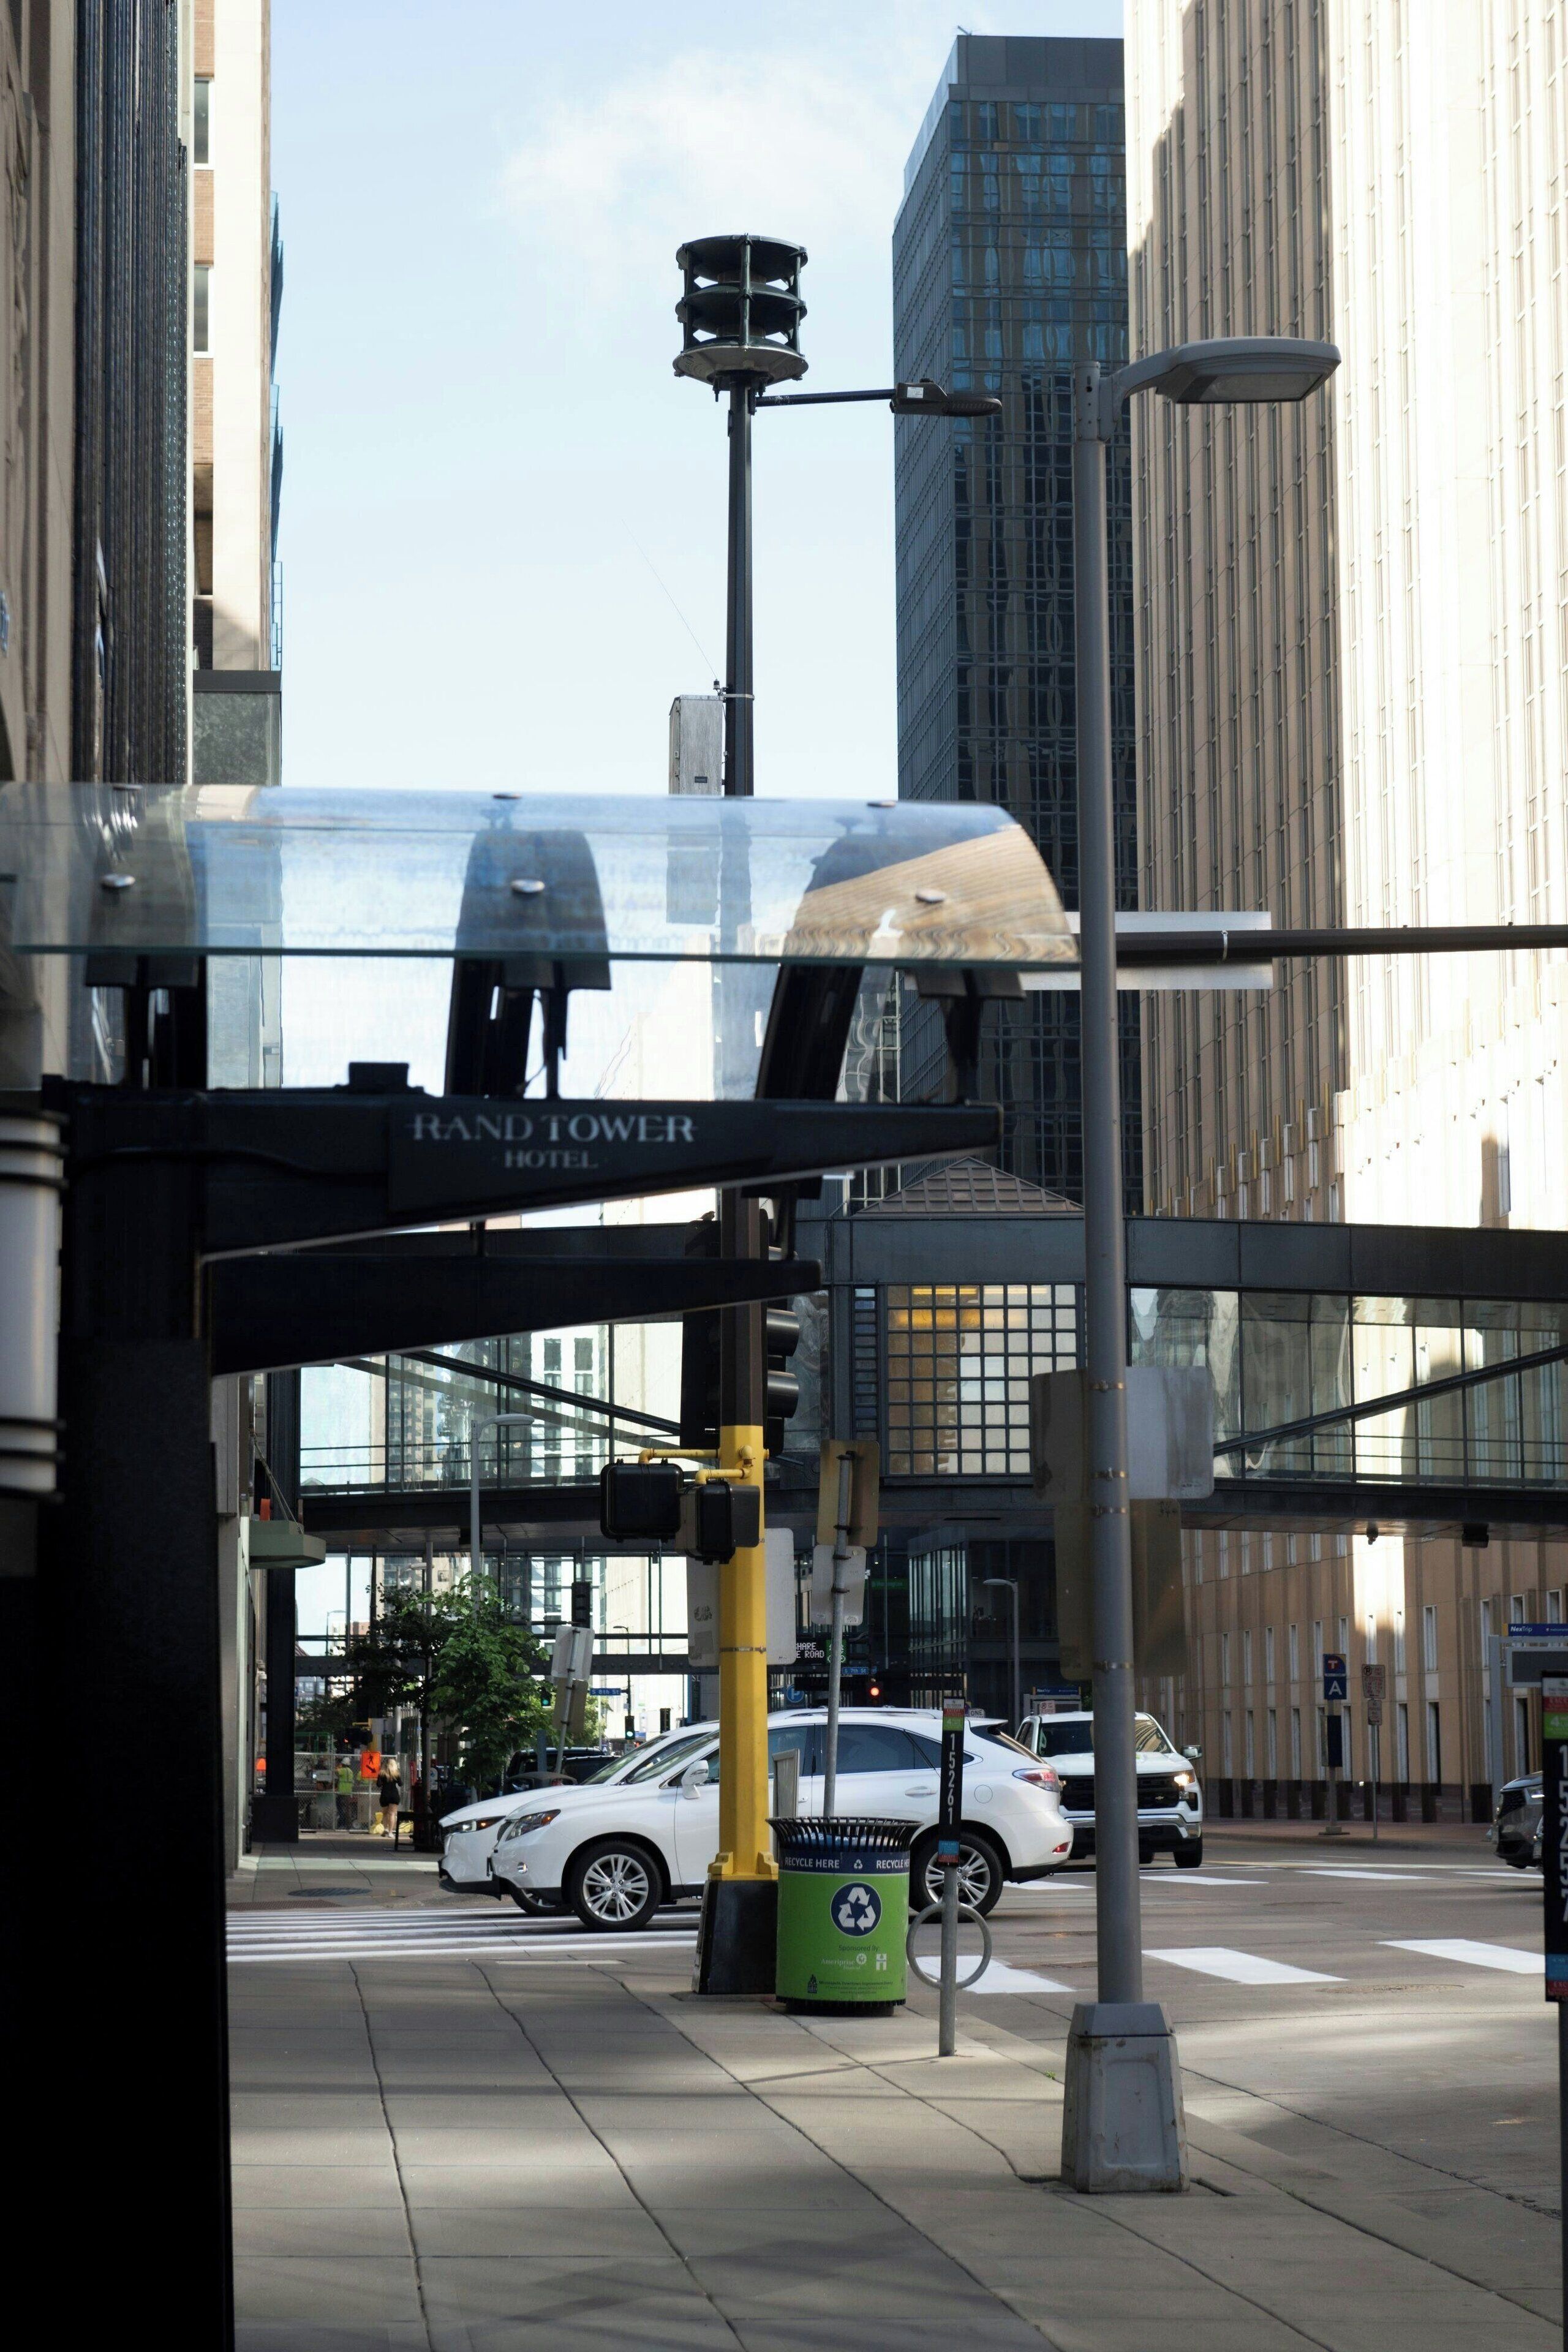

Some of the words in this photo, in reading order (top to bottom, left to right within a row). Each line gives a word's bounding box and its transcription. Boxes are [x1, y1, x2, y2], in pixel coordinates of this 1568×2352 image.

[412, 1113, 533, 1141] RAND
[541, 1115, 696, 1143] TOWER
[504, 1150, 599, 1169] HOTEL
[1329, 1680, 1343, 1695] A
[785, 1856, 813, 1868] RECYCLE
[815, 1859, 840, 1869] HERE
[876, 1860, 904, 1869] RECYCLE
